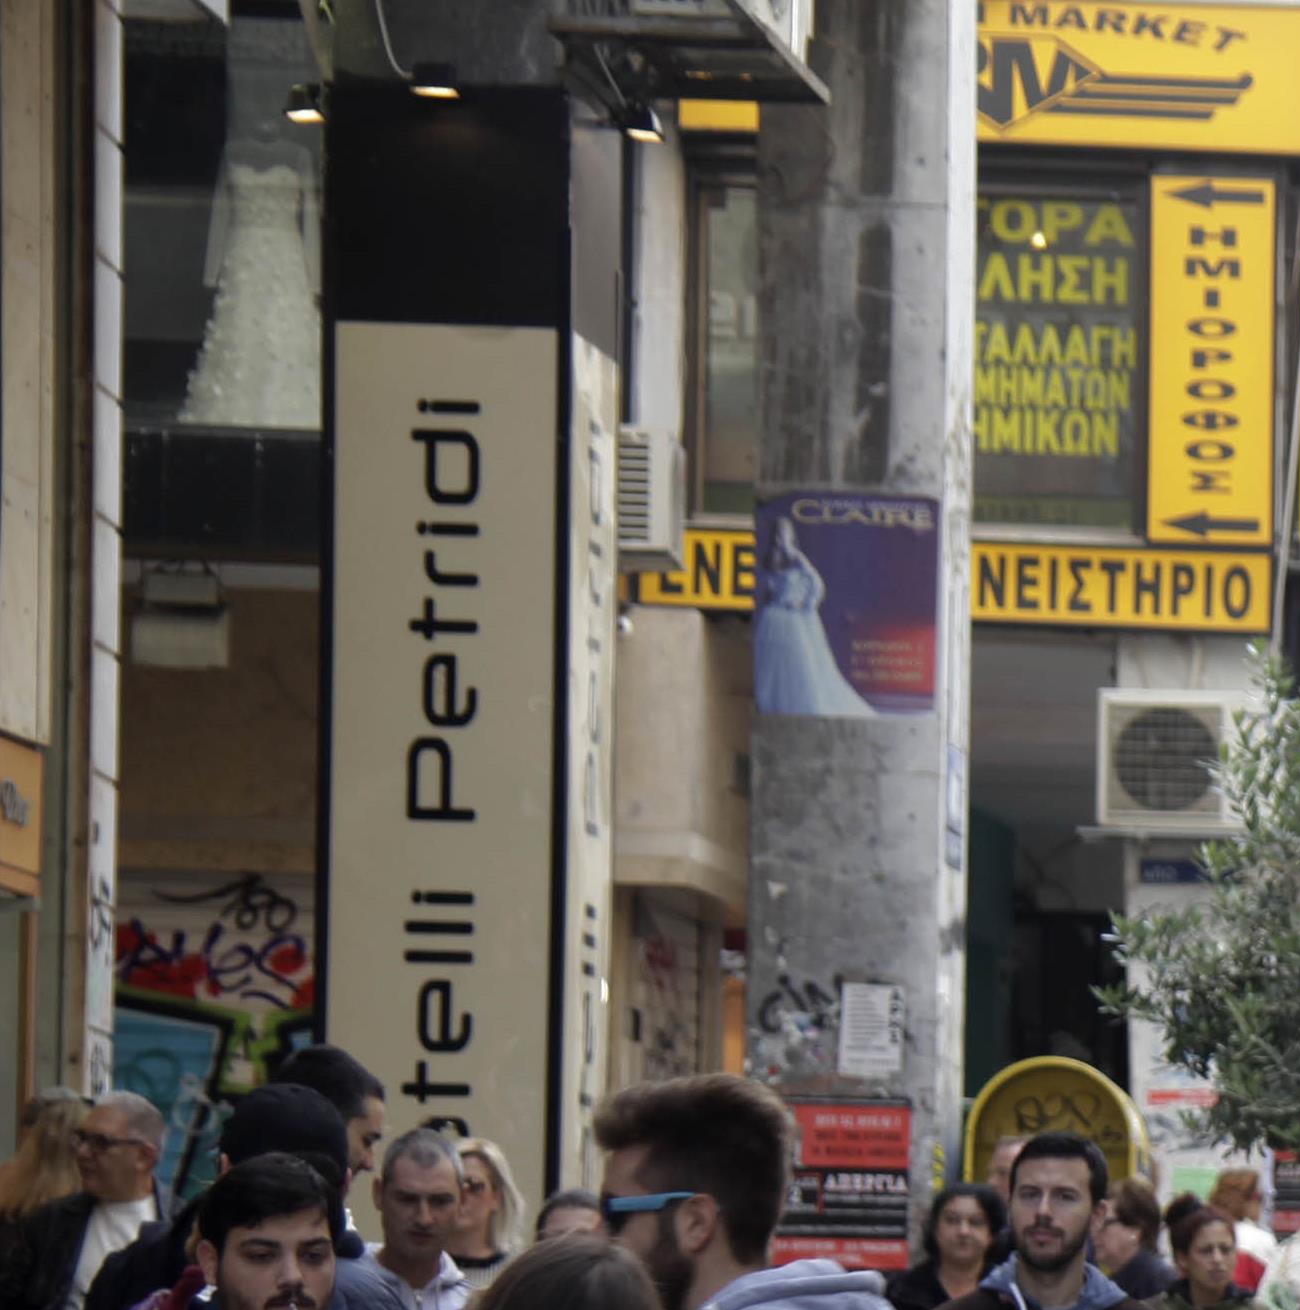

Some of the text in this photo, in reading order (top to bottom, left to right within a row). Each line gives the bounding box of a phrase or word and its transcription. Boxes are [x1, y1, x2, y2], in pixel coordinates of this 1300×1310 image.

[1008, 3, 1246, 54] MARKET
[1180, 224, 1241, 496] ΗΜΙΟΡΟΦΟΣ
[791, 499, 934, 531] CLAIRE
[405, 398, 482, 821] Petridi
[977, 554, 1252, 620] ΝΕΙΣΤΗΡΙΟ
